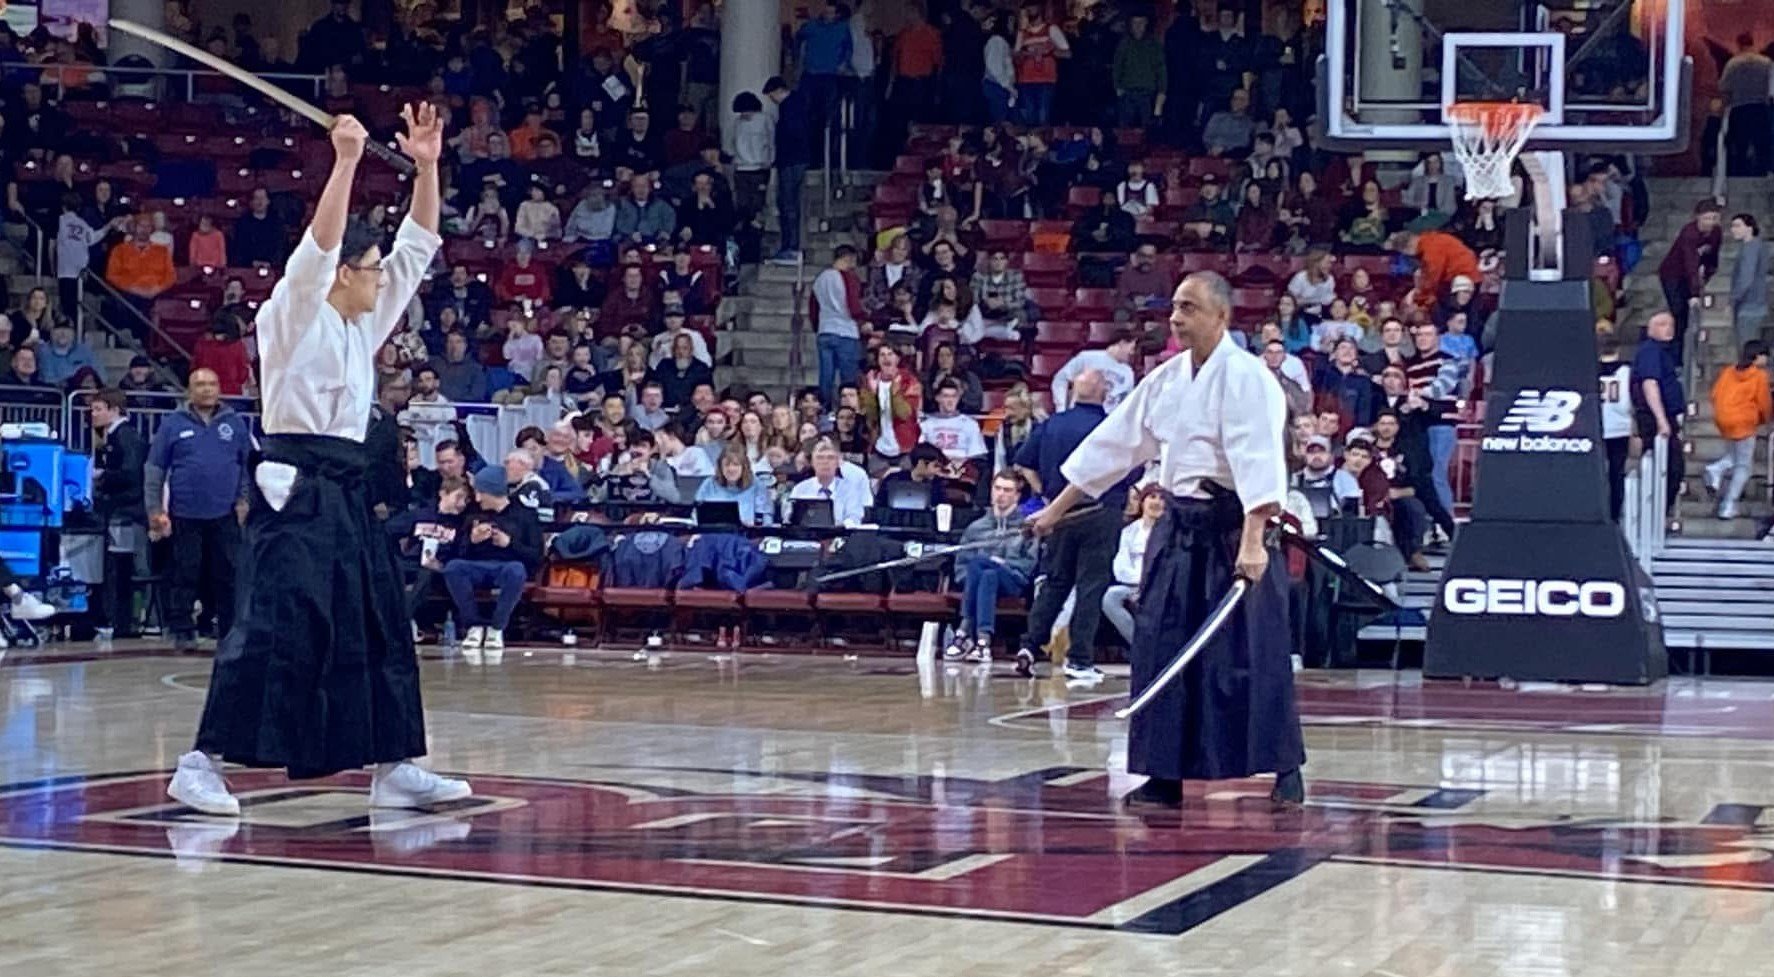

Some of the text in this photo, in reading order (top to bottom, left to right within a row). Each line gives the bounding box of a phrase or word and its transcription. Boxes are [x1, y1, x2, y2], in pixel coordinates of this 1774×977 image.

[1498, 390, 1582, 432] NB
[1482, 435, 1592, 453] new balance
[1444, 578, 1625, 616] GEICO
